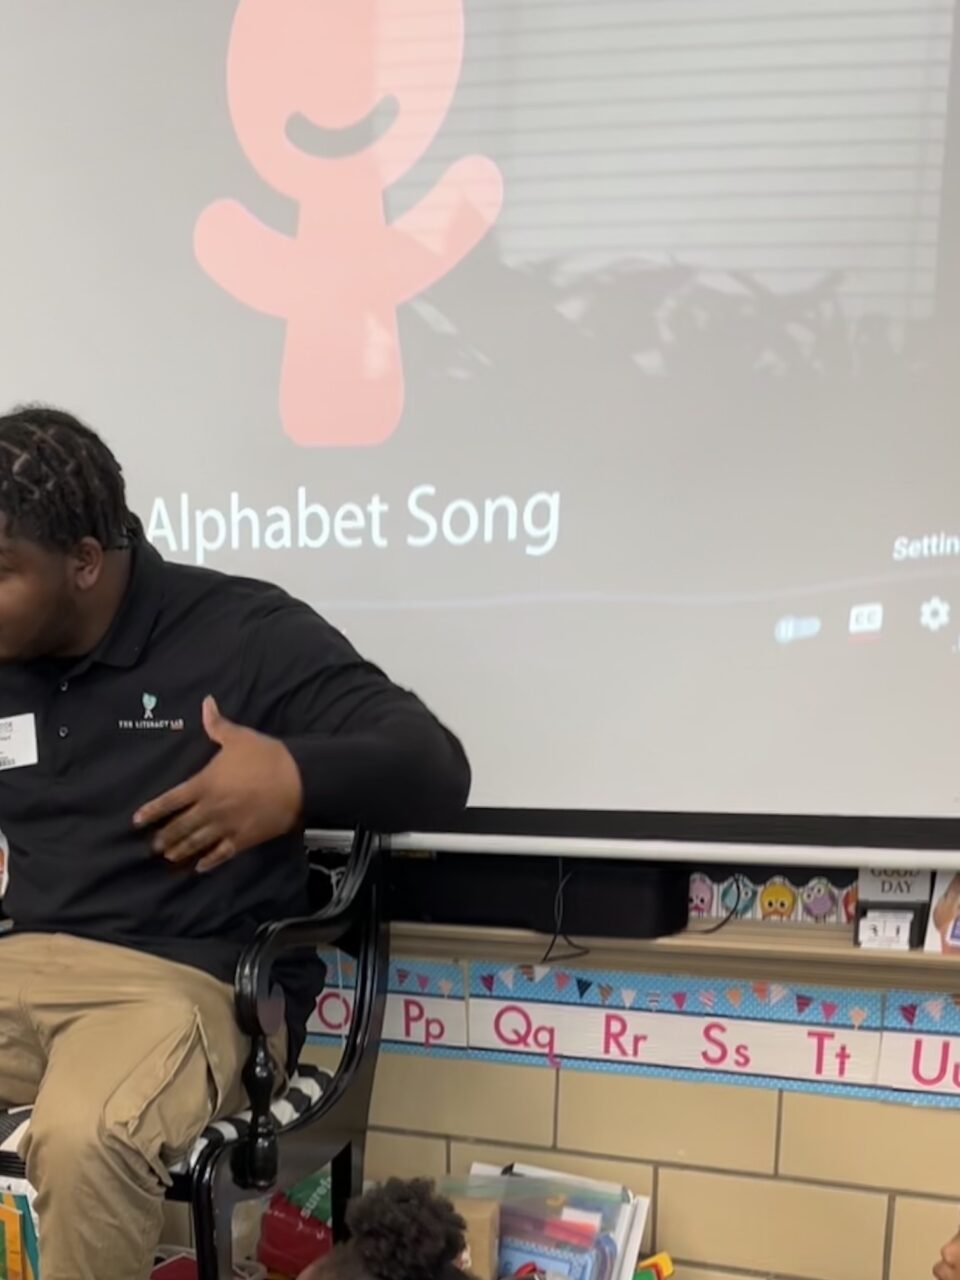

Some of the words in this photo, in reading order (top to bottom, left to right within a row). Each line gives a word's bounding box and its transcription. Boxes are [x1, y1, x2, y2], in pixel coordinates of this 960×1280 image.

[146, 486, 389, 564] Alphabet
[407, 484, 561, 556] Song
[880, 880, 912, 894] DAY
[402, 999, 446, 1048] Pp
[493, 1005, 561, 1068] Qq
[603, 1014, 648, 1058] Rr
[701, 1022, 751, 1068] Ss
[807, 1031, 851, 1078] Tt
